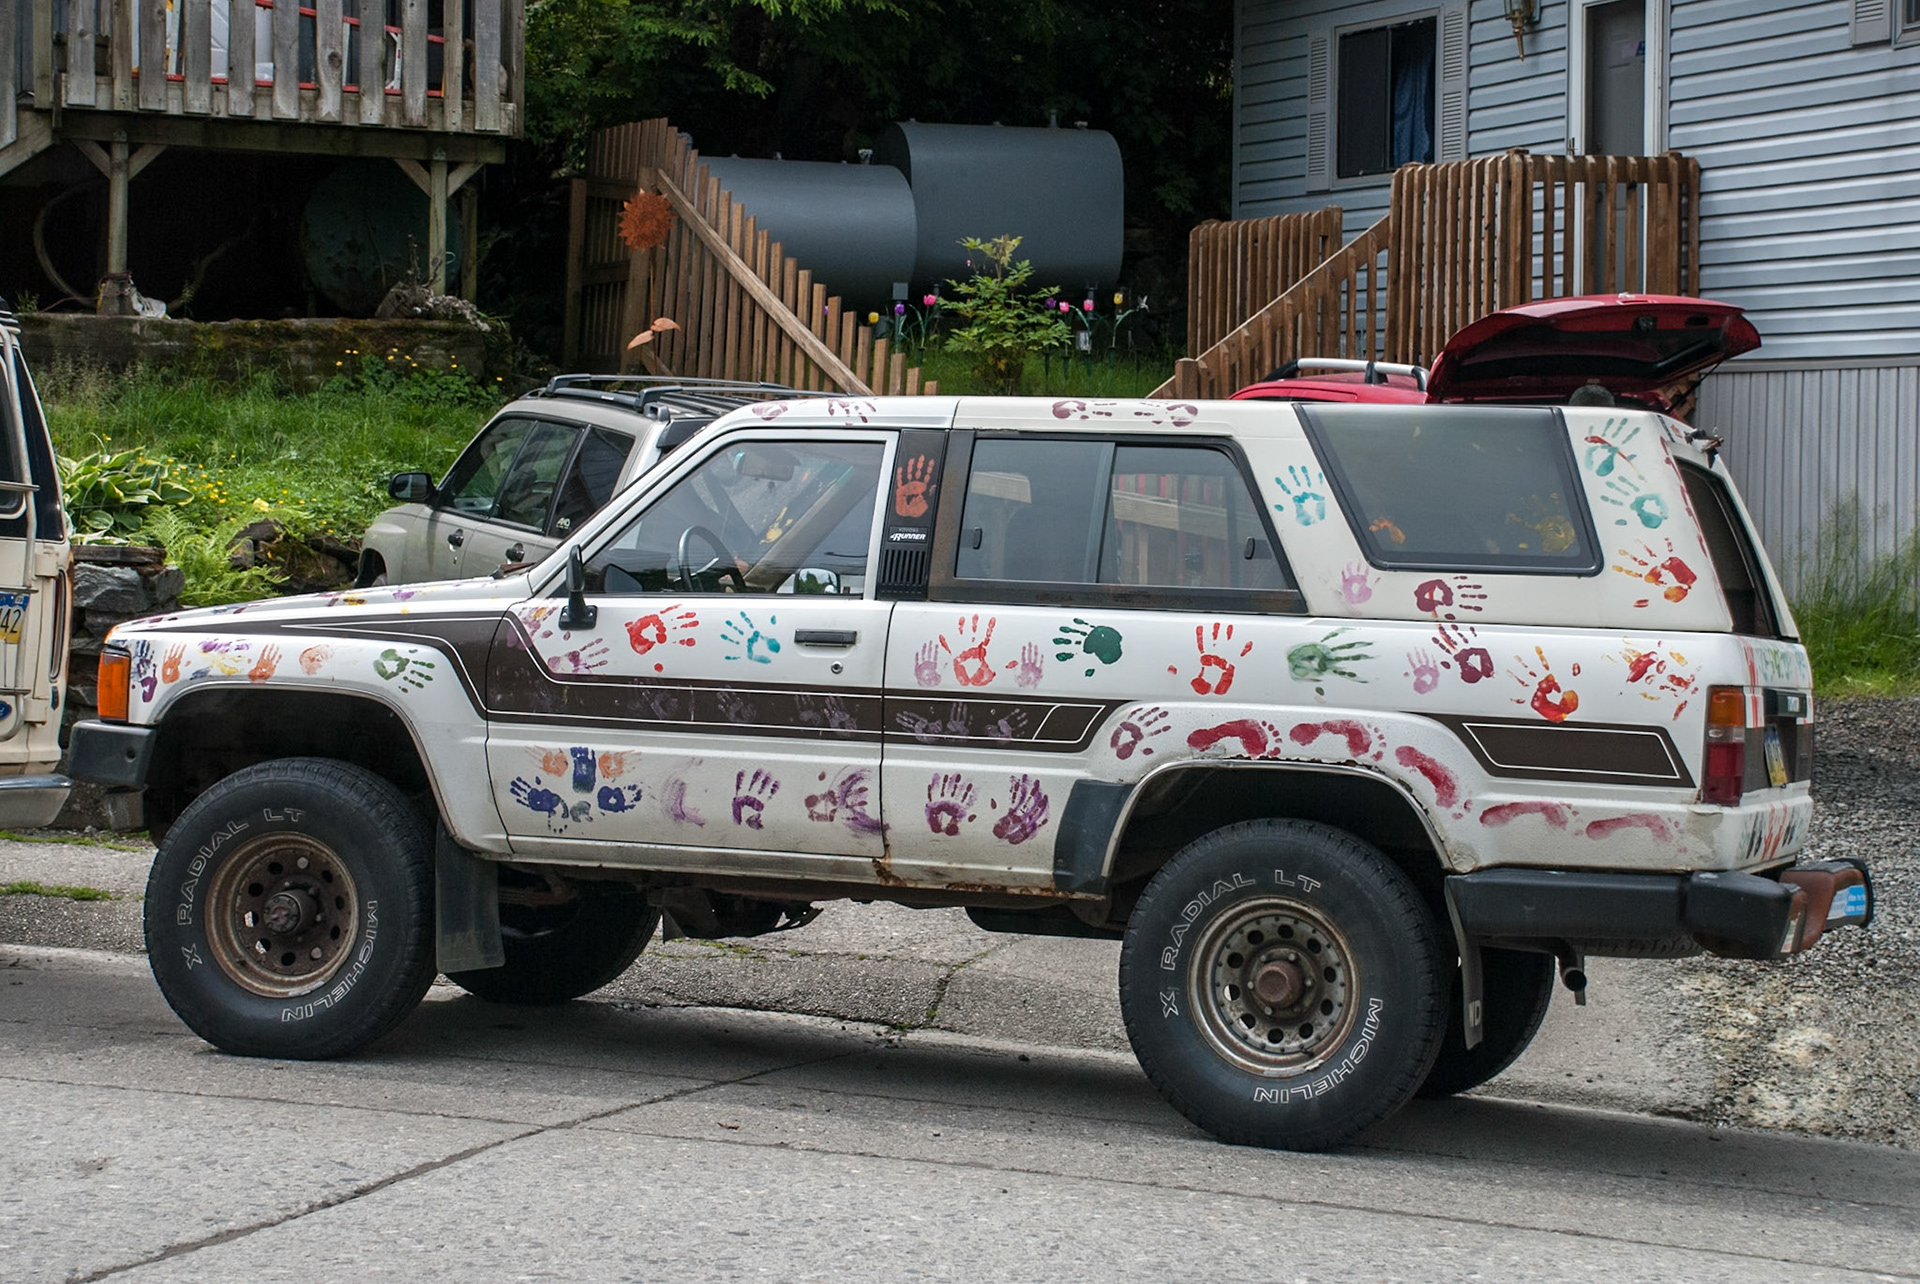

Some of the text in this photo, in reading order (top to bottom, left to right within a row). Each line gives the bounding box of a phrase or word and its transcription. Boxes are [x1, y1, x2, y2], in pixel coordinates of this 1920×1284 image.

[0, 608, 21, 633] 42
[177, 807, 305, 971] X RADIAL LT
[1160, 869, 1321, 1018] X RADIAL LT
[281, 900, 378, 1022] MICHELIN
[1253, 997, 1383, 1104] MICHELIN
